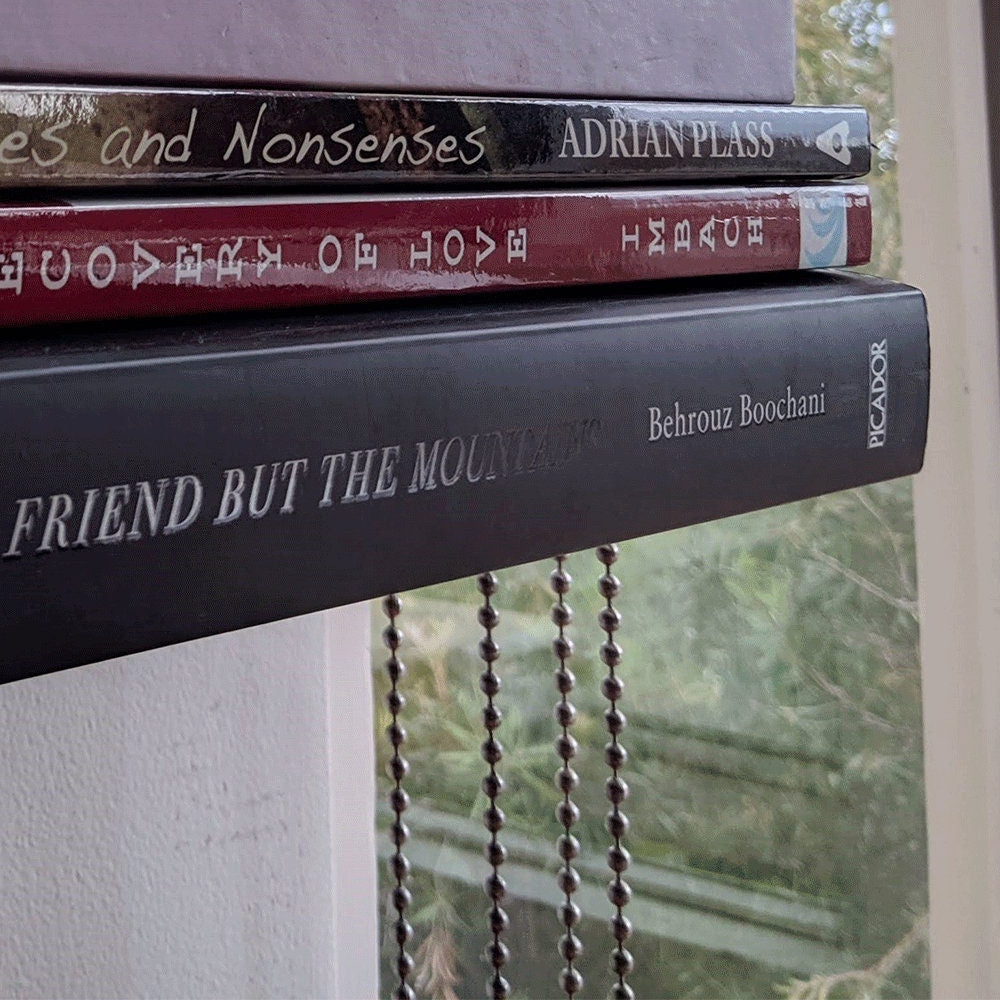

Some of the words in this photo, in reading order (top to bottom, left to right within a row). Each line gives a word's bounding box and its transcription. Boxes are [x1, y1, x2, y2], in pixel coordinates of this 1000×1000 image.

[101, 107, 198, 169] and
[222, 103, 487, 168] Nonsenses
[558, 117, 684, 159] ADRIAN
[691, 119, 775, 158] PLASS
[318, 233, 378, 274] OF
[410, 224, 528, 268] LOVE
[621, 215, 765, 256] IMBACH
[648, 400, 733, 442] Behrouz
[738, 382, 826, 428] Boochani
[867, 337, 889, 450] PICADOR
[2, 474, 204, 561] FRIEND
[213, 458, 309, 525] BUT
[318, 445, 400, 508] THE
